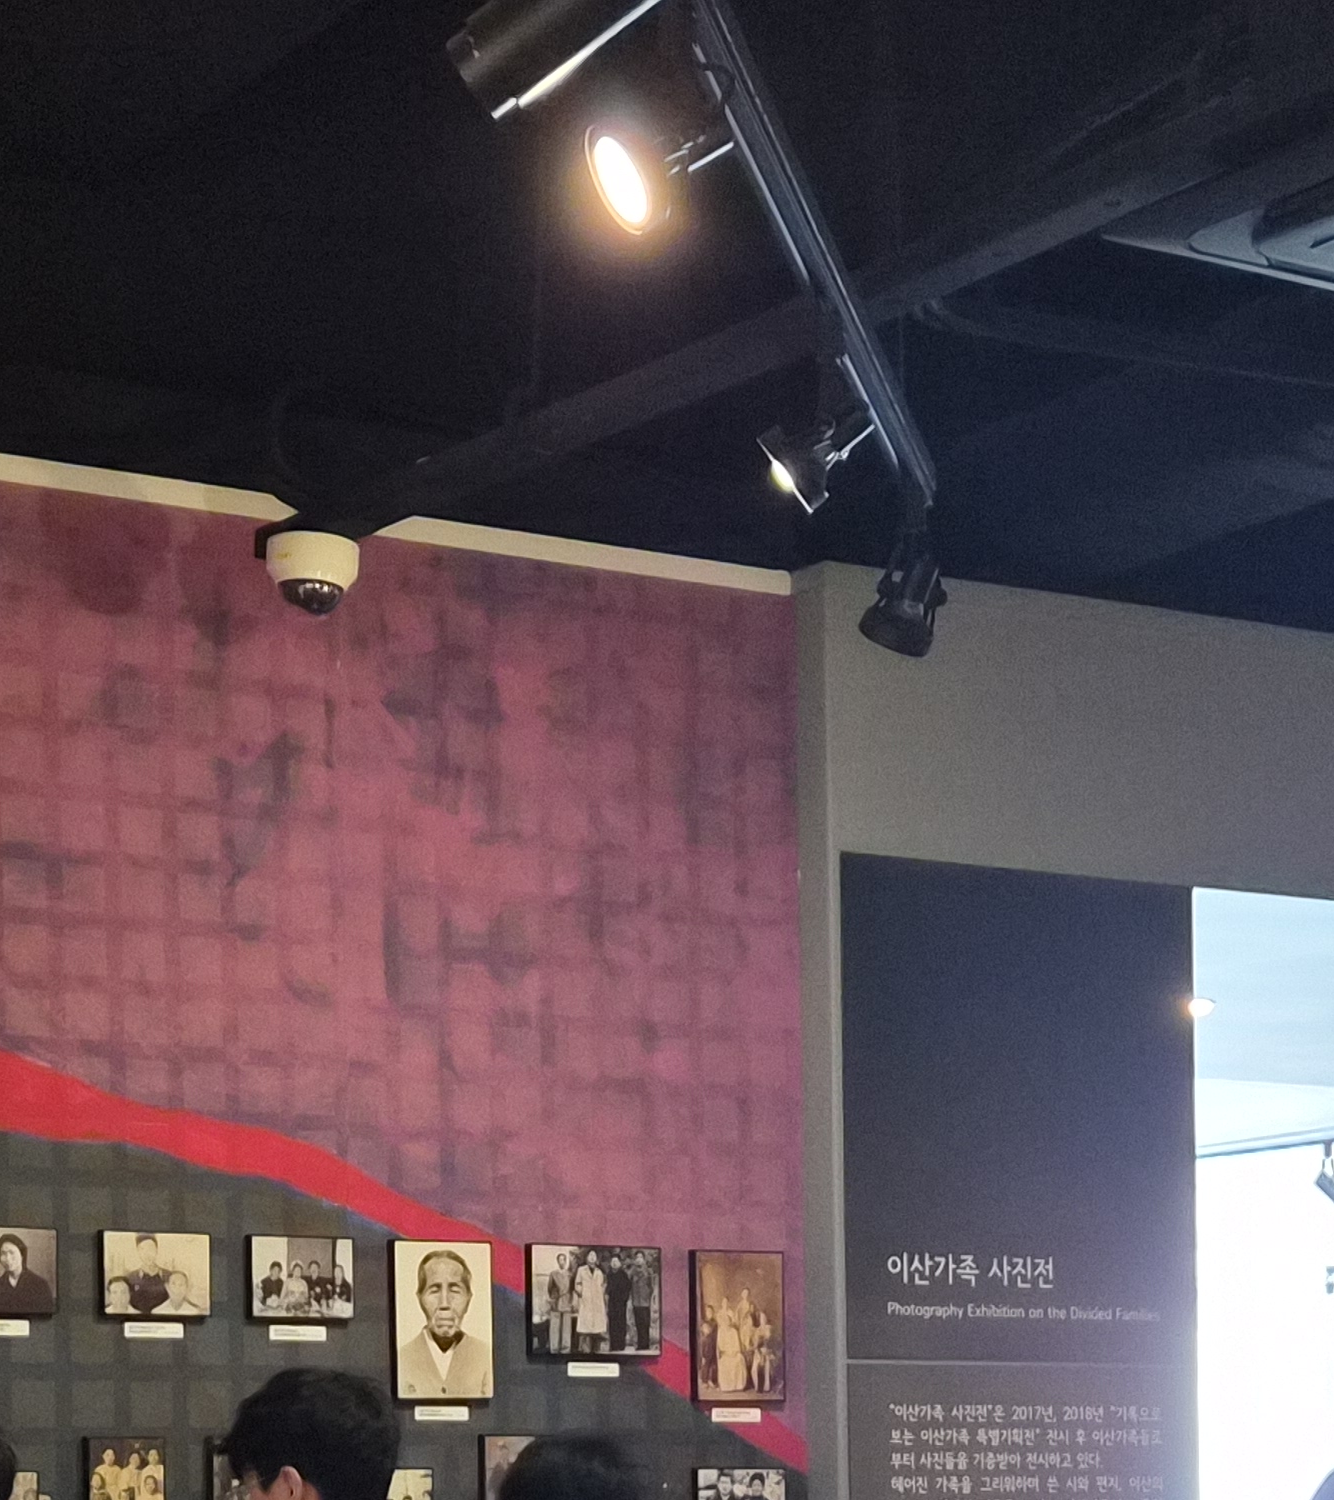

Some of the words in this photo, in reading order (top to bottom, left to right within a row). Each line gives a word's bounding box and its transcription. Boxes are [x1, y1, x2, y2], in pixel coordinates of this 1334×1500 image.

[887, 1251, 980, 1287] 이산가족
[987, 1254, 1054, 1288] 사진전
[887, 1301, 964, 1320] Photography
[967, 1302, 1025, 1318] Exhibition
[1028, 1307, 1044, 1318] on
[1047, 1306, 1067, 1320] the
[1070, 1305, 1112, 1320] Divided
[888, 1428, 916, 1446] 보는
[920, 1427, 971, 1446] 이산가족
[1046, 1428, 1069, 1446] 전시
[889, 1451, 915, 1470] 부터
[919, 1451, 969, 1470] 사진들을
[1026, 1451, 1074, 1470] 전시하고
[890, 1475, 928, 1494] 헤어진
[935, 1475, 973, 1495] 가족을
[979, 1475, 1040, 1494] 그리워하며
[1066, 1475, 1089, 1493] 시와
